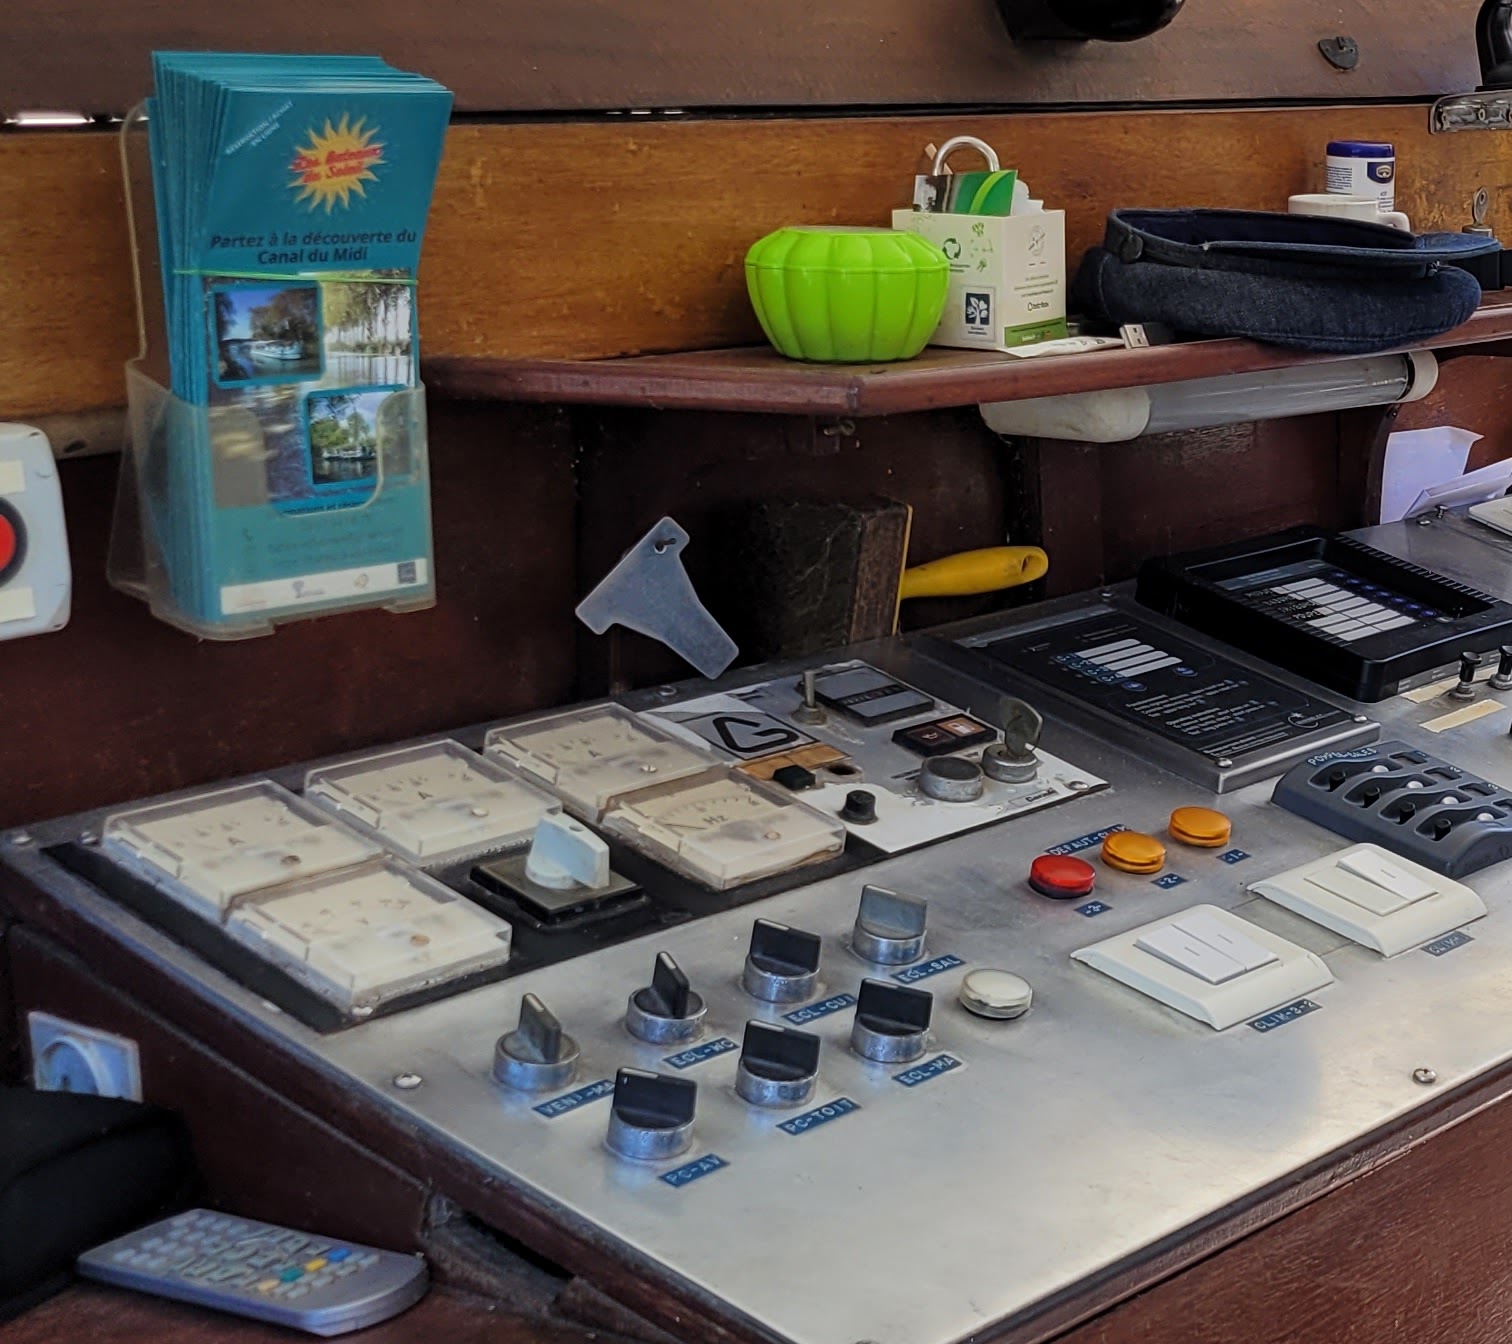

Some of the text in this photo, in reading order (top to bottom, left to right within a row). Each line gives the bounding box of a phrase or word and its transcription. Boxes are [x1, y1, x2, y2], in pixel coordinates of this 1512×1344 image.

[210, 229, 417, 250] Partez à la découverte du
[257, 246, 368, 265] Canal du Midi
[897, 956, 961, 983] ECL-SAL
[789, 995, 855, 1022] ECL-CUI
[672, 1038, 734, 1067] ECL-WC
[899, 1056, 955, 1085] ECL-MA
[784, 1099, 853, 1132] PC-TOIT
